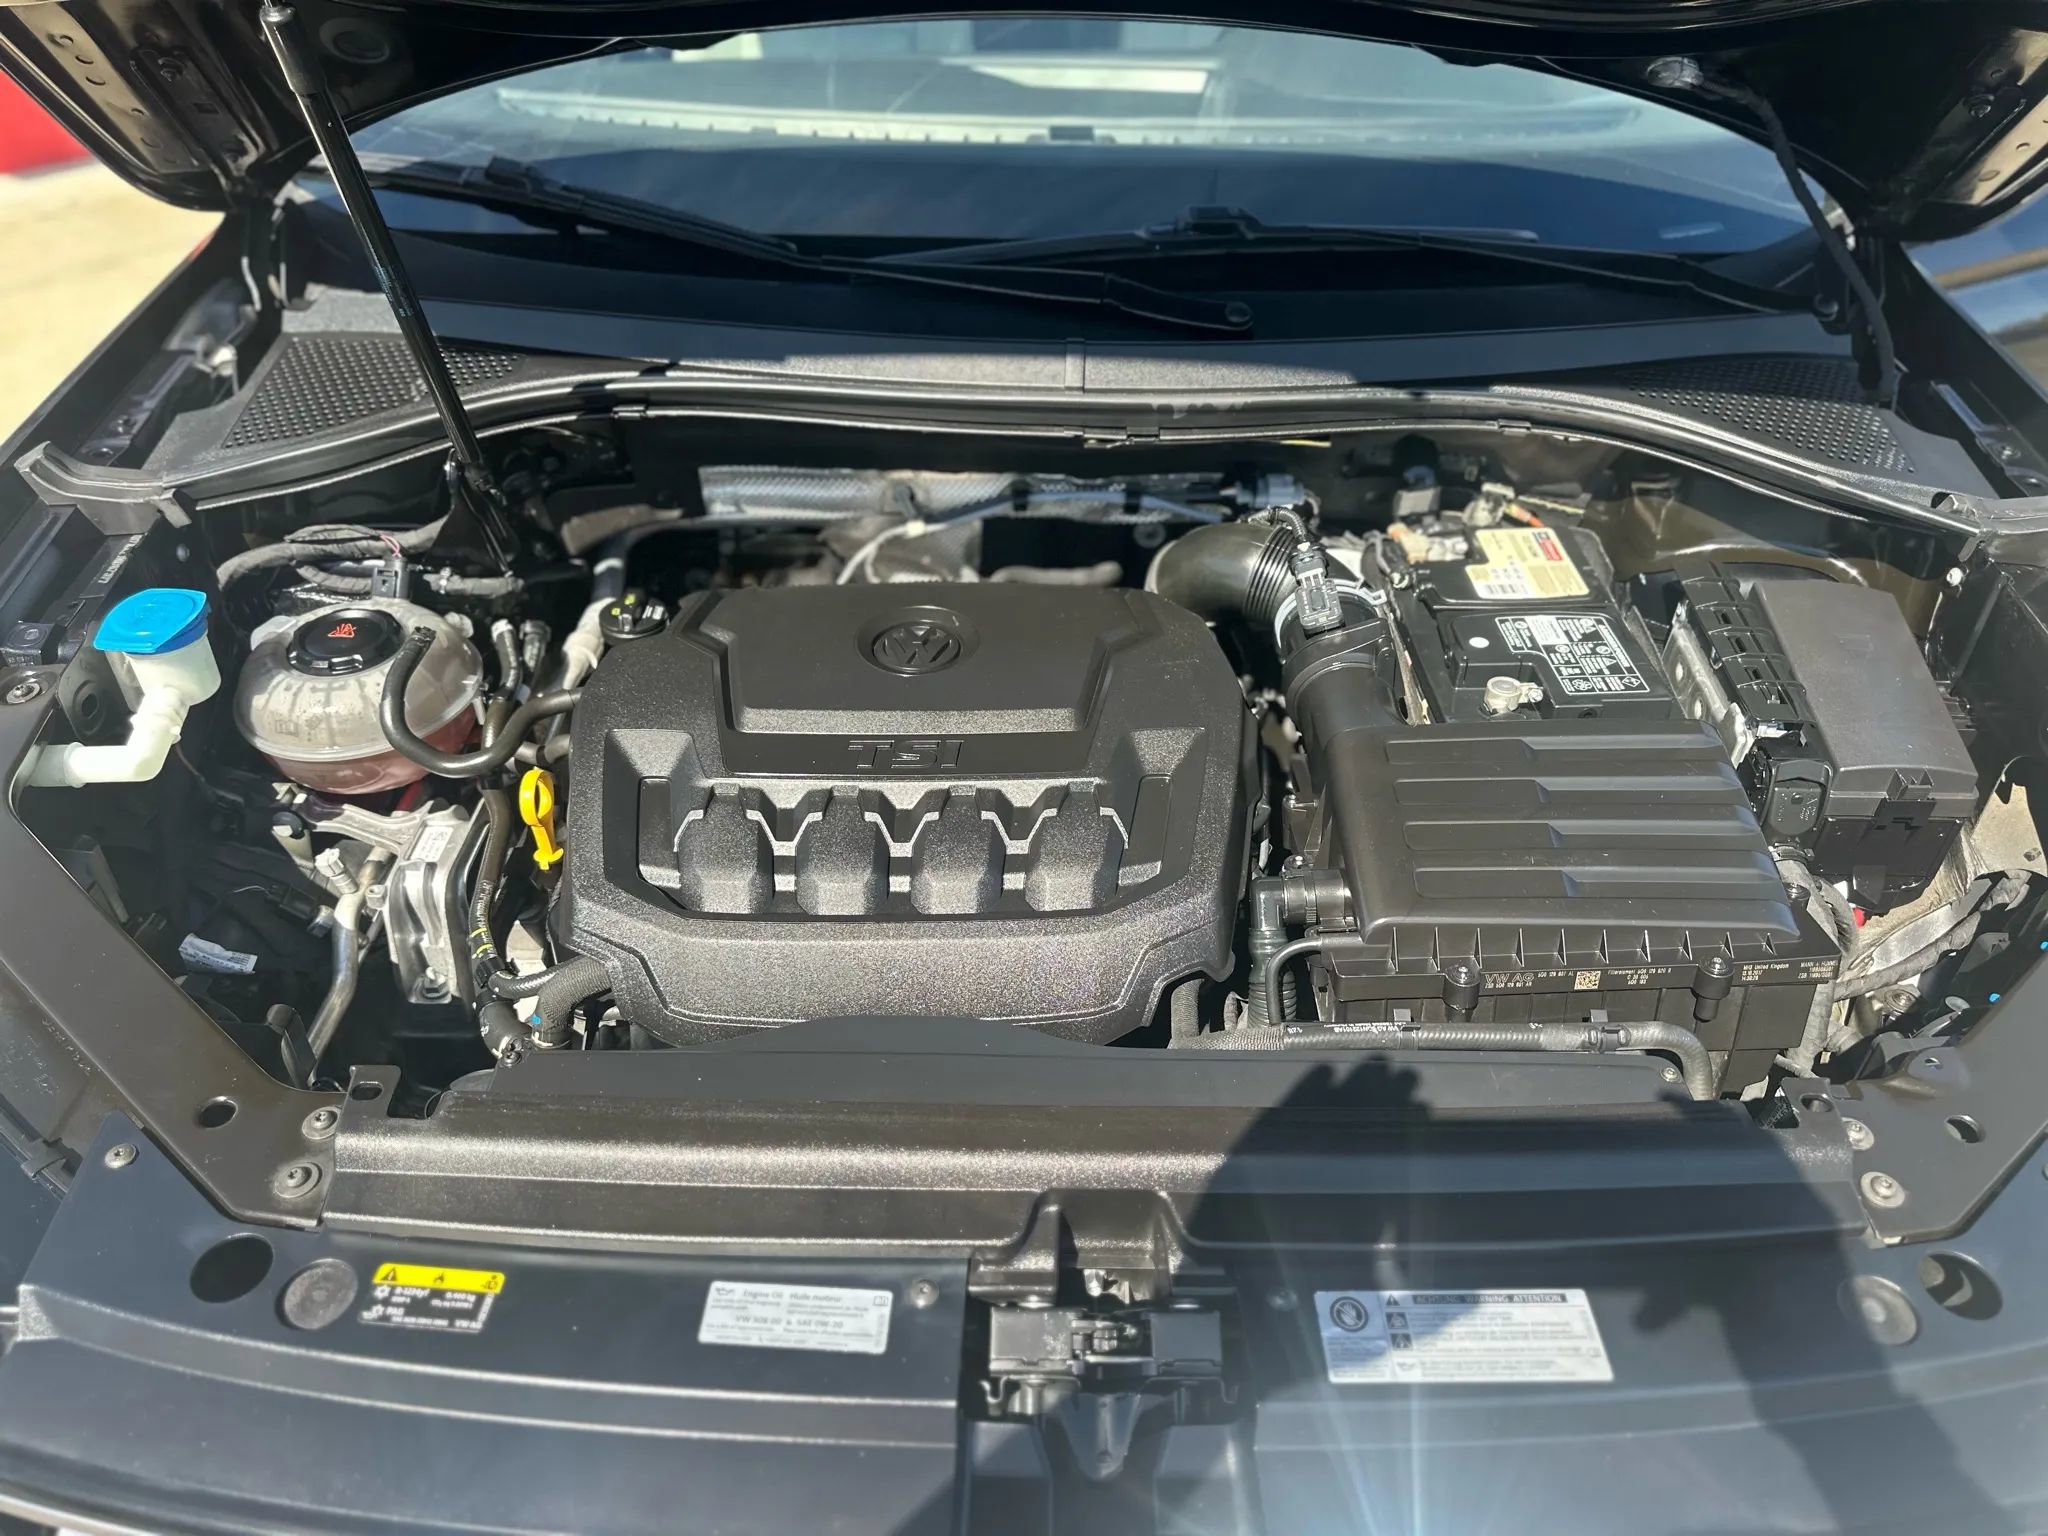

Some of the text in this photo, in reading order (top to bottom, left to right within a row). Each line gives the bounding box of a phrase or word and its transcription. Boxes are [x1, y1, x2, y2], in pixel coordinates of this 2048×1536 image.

[848, 740, 964, 768] TSI
[1485, 972, 1535, 983] VW AG
[1465, 1294, 1509, 1304] WARNING
[1512, 1293, 1562, 1303] ATTENTION
